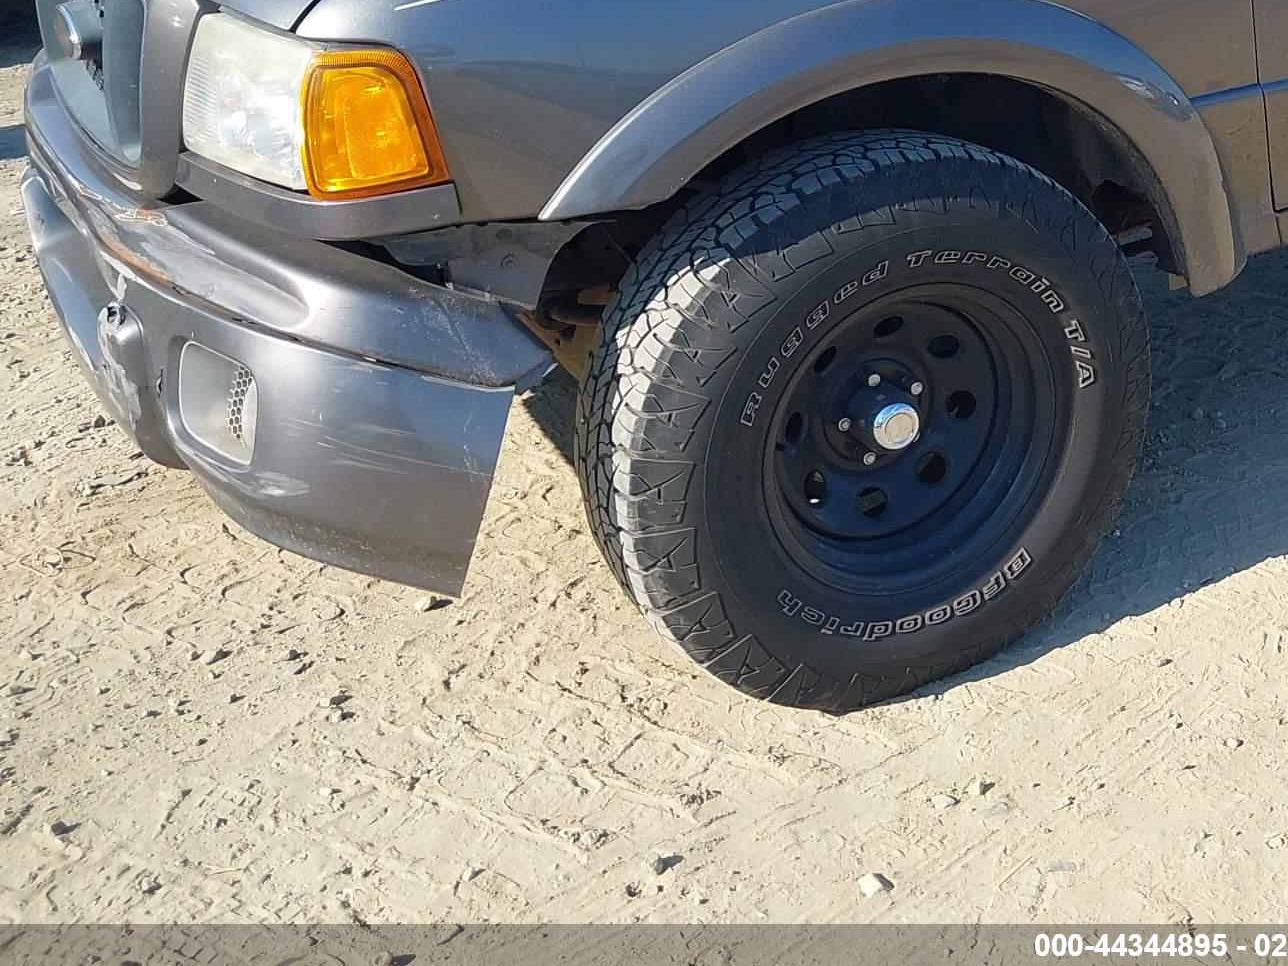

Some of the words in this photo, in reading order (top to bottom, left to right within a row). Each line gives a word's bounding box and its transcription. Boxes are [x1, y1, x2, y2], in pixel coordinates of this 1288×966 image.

[739, 259, 890, 427] Rugged
[905, 249, 1066, 314] Terrain
[1063, 318, 1096, 389] T/A
[776, 545, 1034, 643] BFGoodrich
